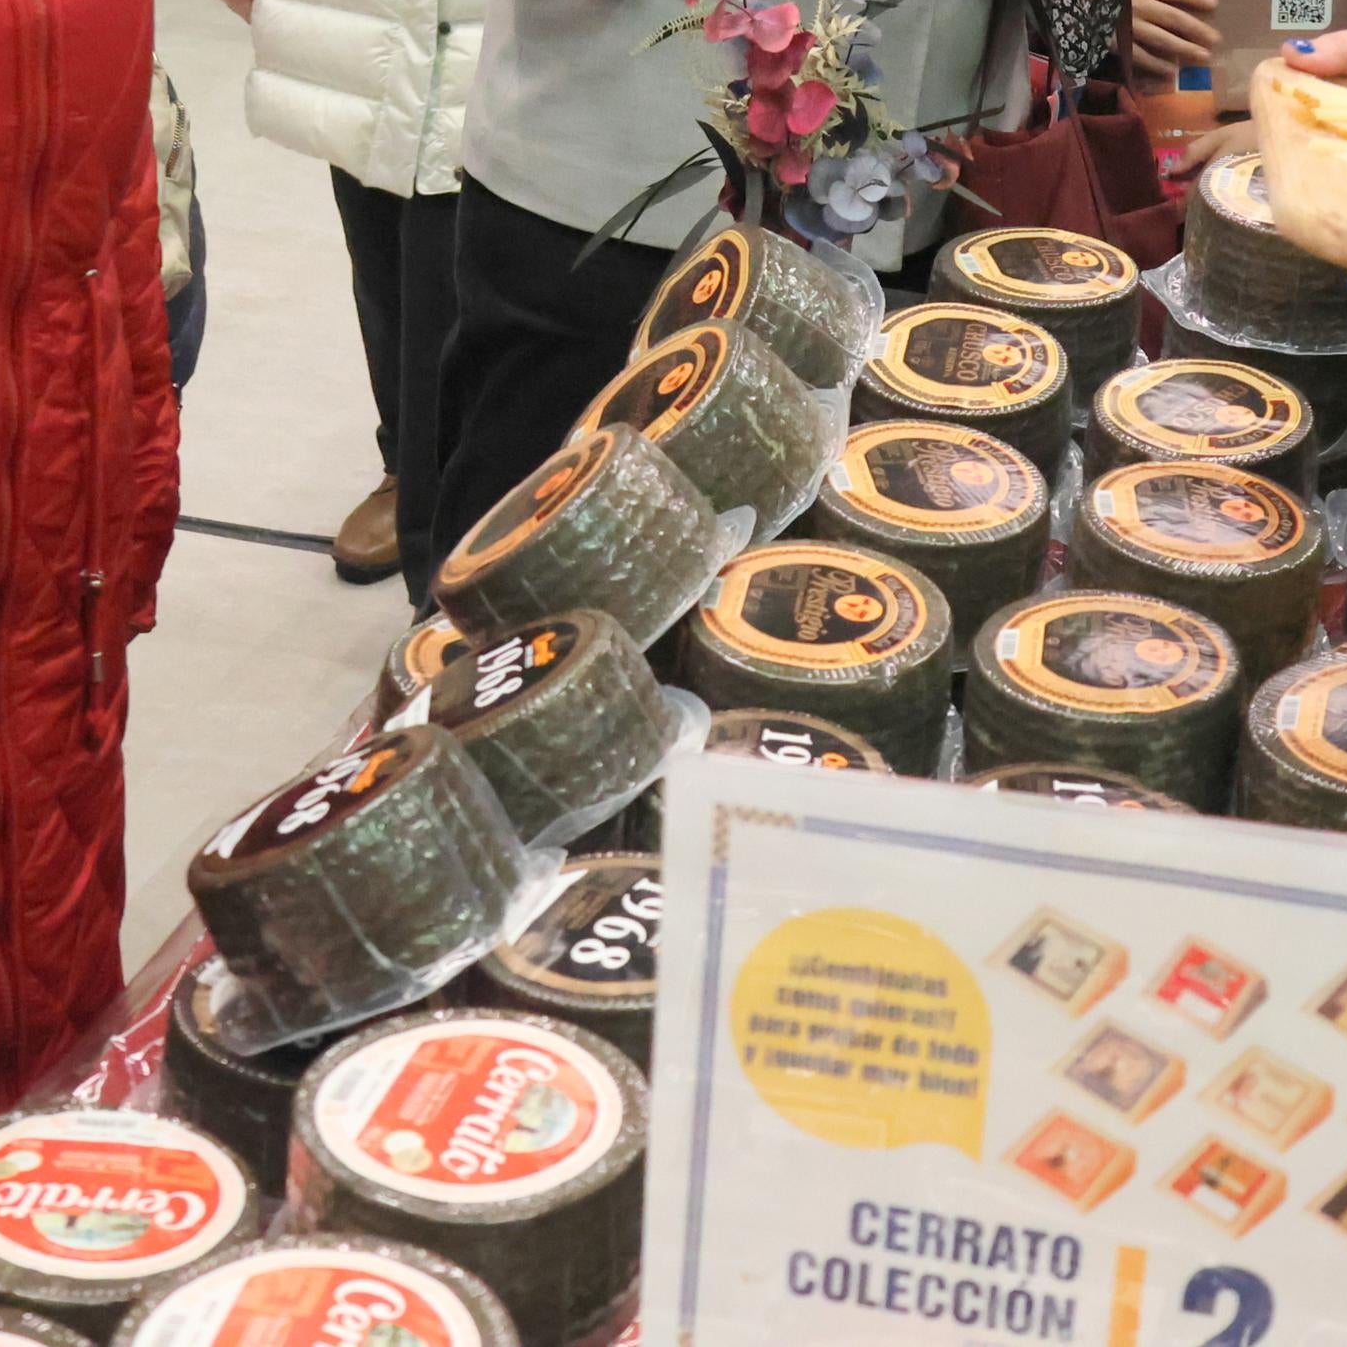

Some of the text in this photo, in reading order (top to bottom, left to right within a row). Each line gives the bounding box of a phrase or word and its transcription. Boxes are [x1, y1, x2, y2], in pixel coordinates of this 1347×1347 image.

[956, 323, 988, 382] CHUSCO
[794, 567, 856, 642] Prestigio
[474, 637, 524, 708] 1968
[759, 728, 812, 766] 19
[439, 1047, 559, 1180] Cerrato
[850, 1199, 1083, 1283] CERRATO
[787, 1248, 1078, 1342] COLECCIÓN
[1181, 1264, 1276, 1347] 2
